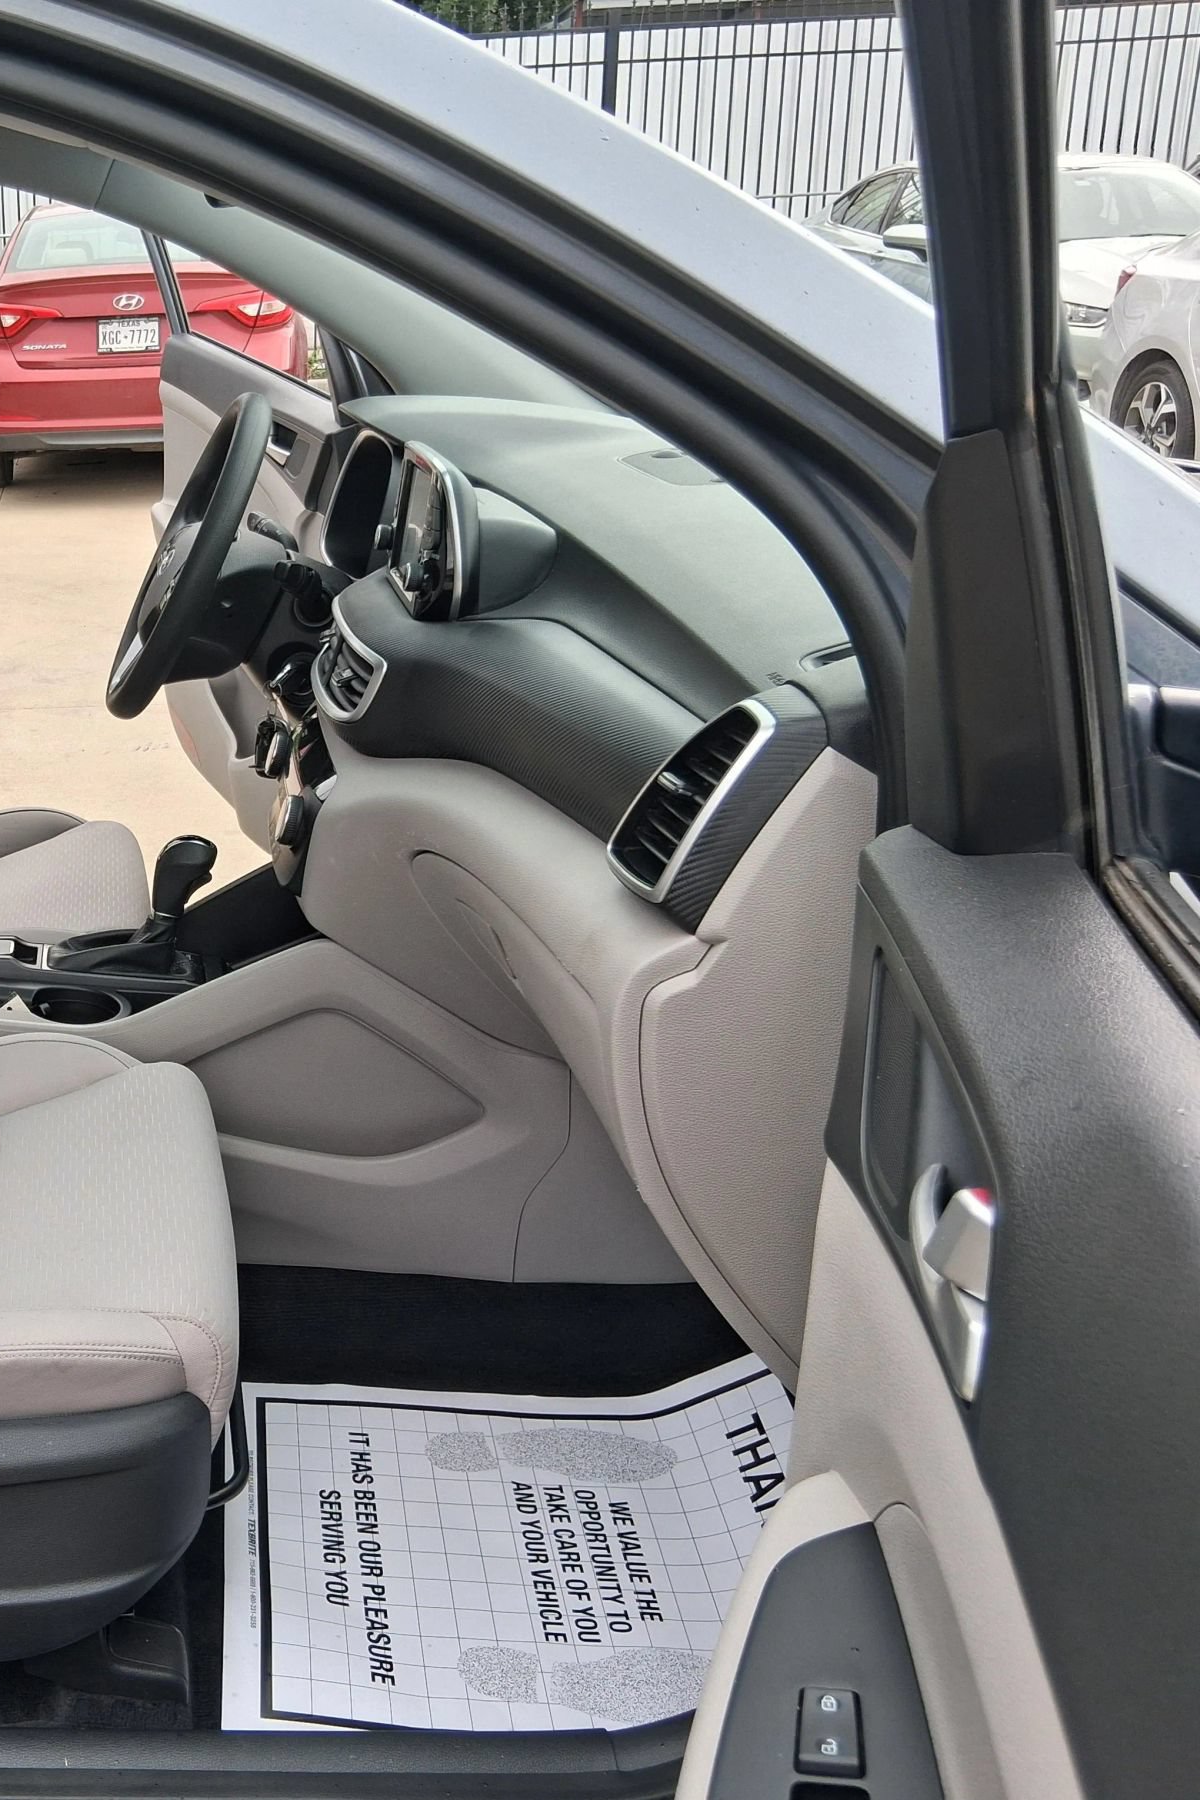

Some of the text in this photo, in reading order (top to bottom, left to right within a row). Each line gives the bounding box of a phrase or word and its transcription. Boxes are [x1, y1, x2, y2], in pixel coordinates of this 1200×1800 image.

[22, 343, 67, 351] SONATA
[247, 1519, 257, 1557] TEXBRITE
[319, 1489, 350, 1607] SERVING YOU
[348, 1431, 396, 1687] IT HAS BEEN OUR PLEASURE
[511, 1480, 568, 1643] AND YOUR VEHICLE
[542, 1484, 602, 1643] TAKE CARE OF YOU
[574, 1489, 633, 1633] OPPORTUNITY TO
[608, 1501, 664, 1622] WE VALUE THE
